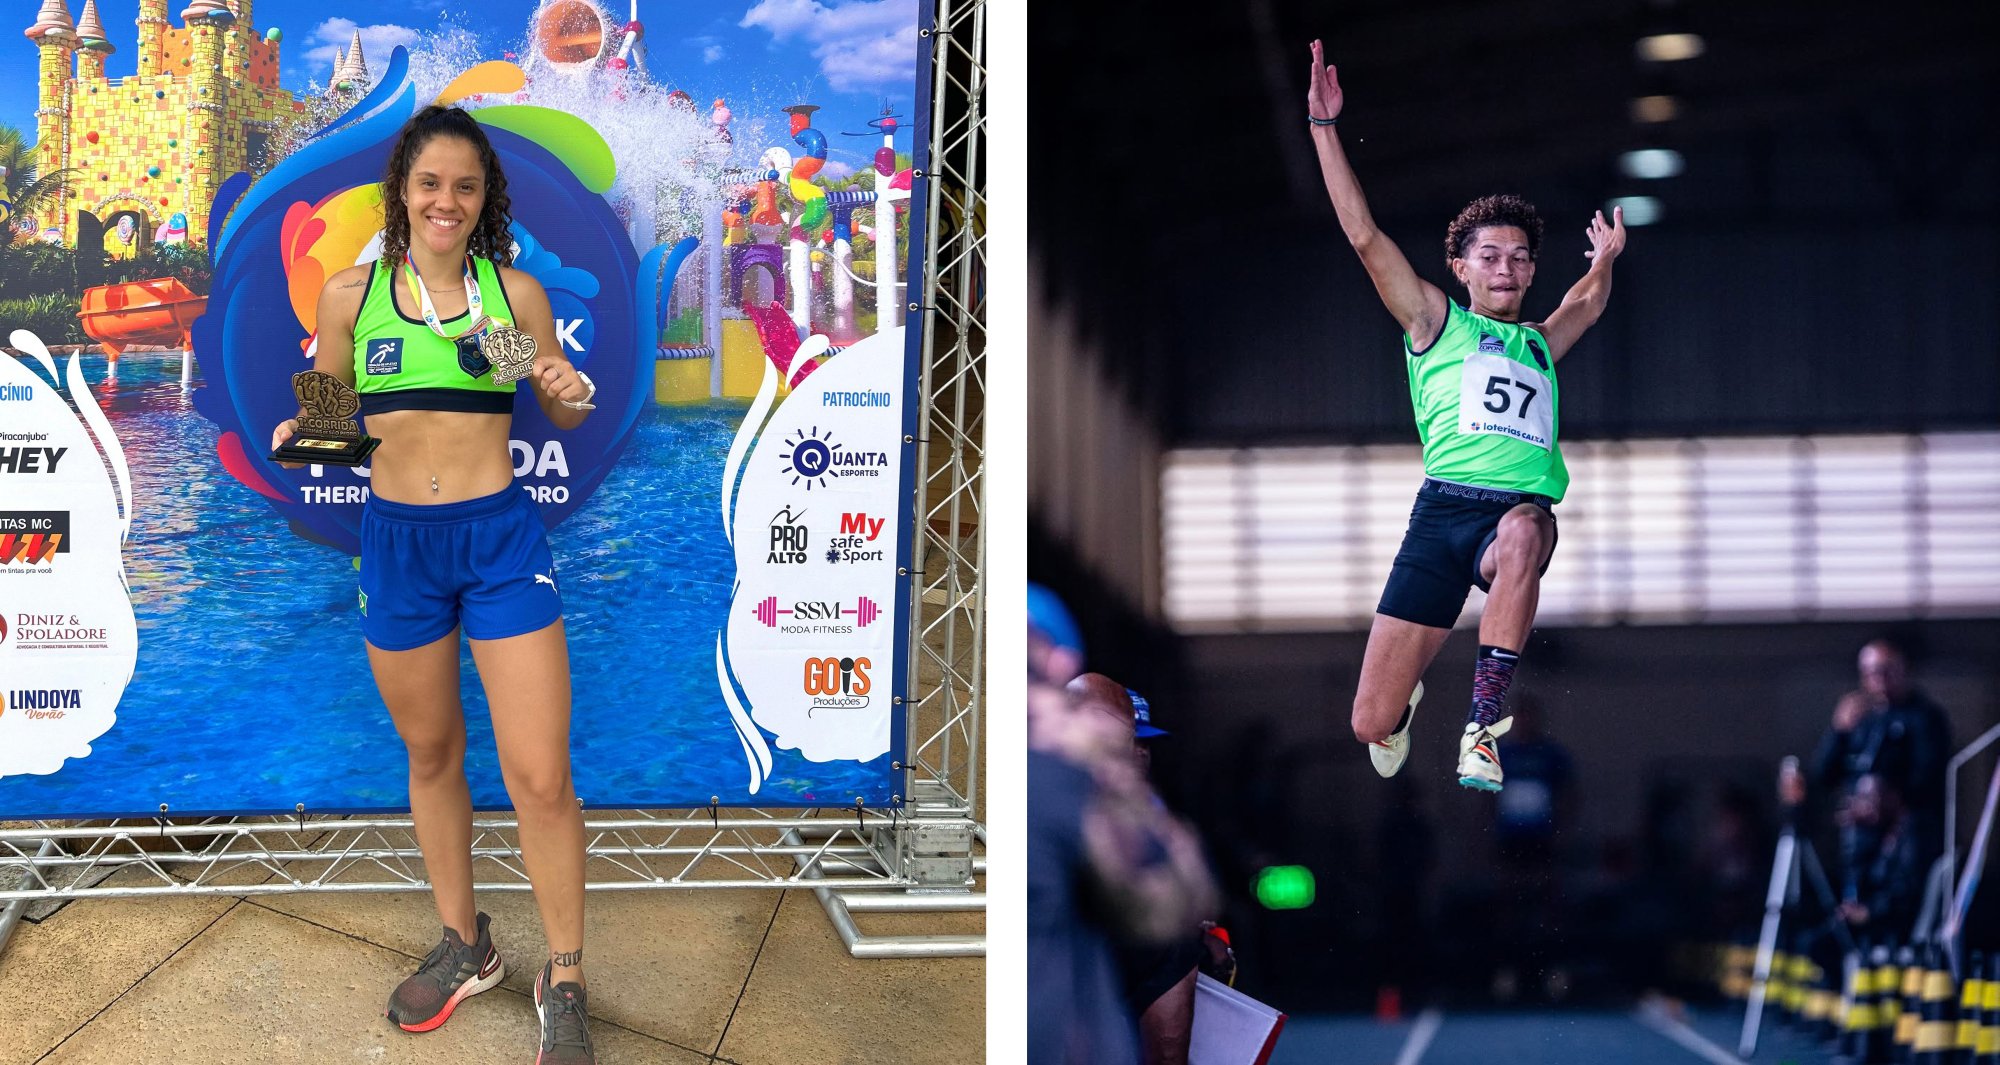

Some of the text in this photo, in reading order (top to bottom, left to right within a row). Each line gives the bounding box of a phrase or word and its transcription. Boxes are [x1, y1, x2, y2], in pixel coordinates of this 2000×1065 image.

[553, 318, 586, 352] K
[501, 362, 534, 379] CORRID
[823, 389, 890, 407] PATROCÍNIO
[1483, 376, 1537, 419] 57
[308, 418, 358, 431] CORRIDA
[0, 431, 47, 443] Piracanjuba
[1483, 422, 1545, 445] loterias CAIXA
[0, 447, 68, 474] HEY
[798, 447, 888, 472] QUANTA
[1438, 482, 1480, 500] NIKE
[1480, 489, 1521, 504] PRO
[31, 518, 52, 530] MC
[840, 512, 885, 541] My
[770, 525, 808, 551] PRO
[830, 535, 864, 549] safe
[766, 552, 808, 564] ALTO
[842, 549, 883, 564] Sport
[794, 601, 840, 620] SSM
[69, 614, 81, 626] &
[16, 627, 107, 640] SPOLADORE
[780, 626, 853, 634] MODA FITNESS
[10, 689, 82, 710] LINDOYA
[813, 697, 861, 707] Produções
[25, 709, 66, 720] Verão
